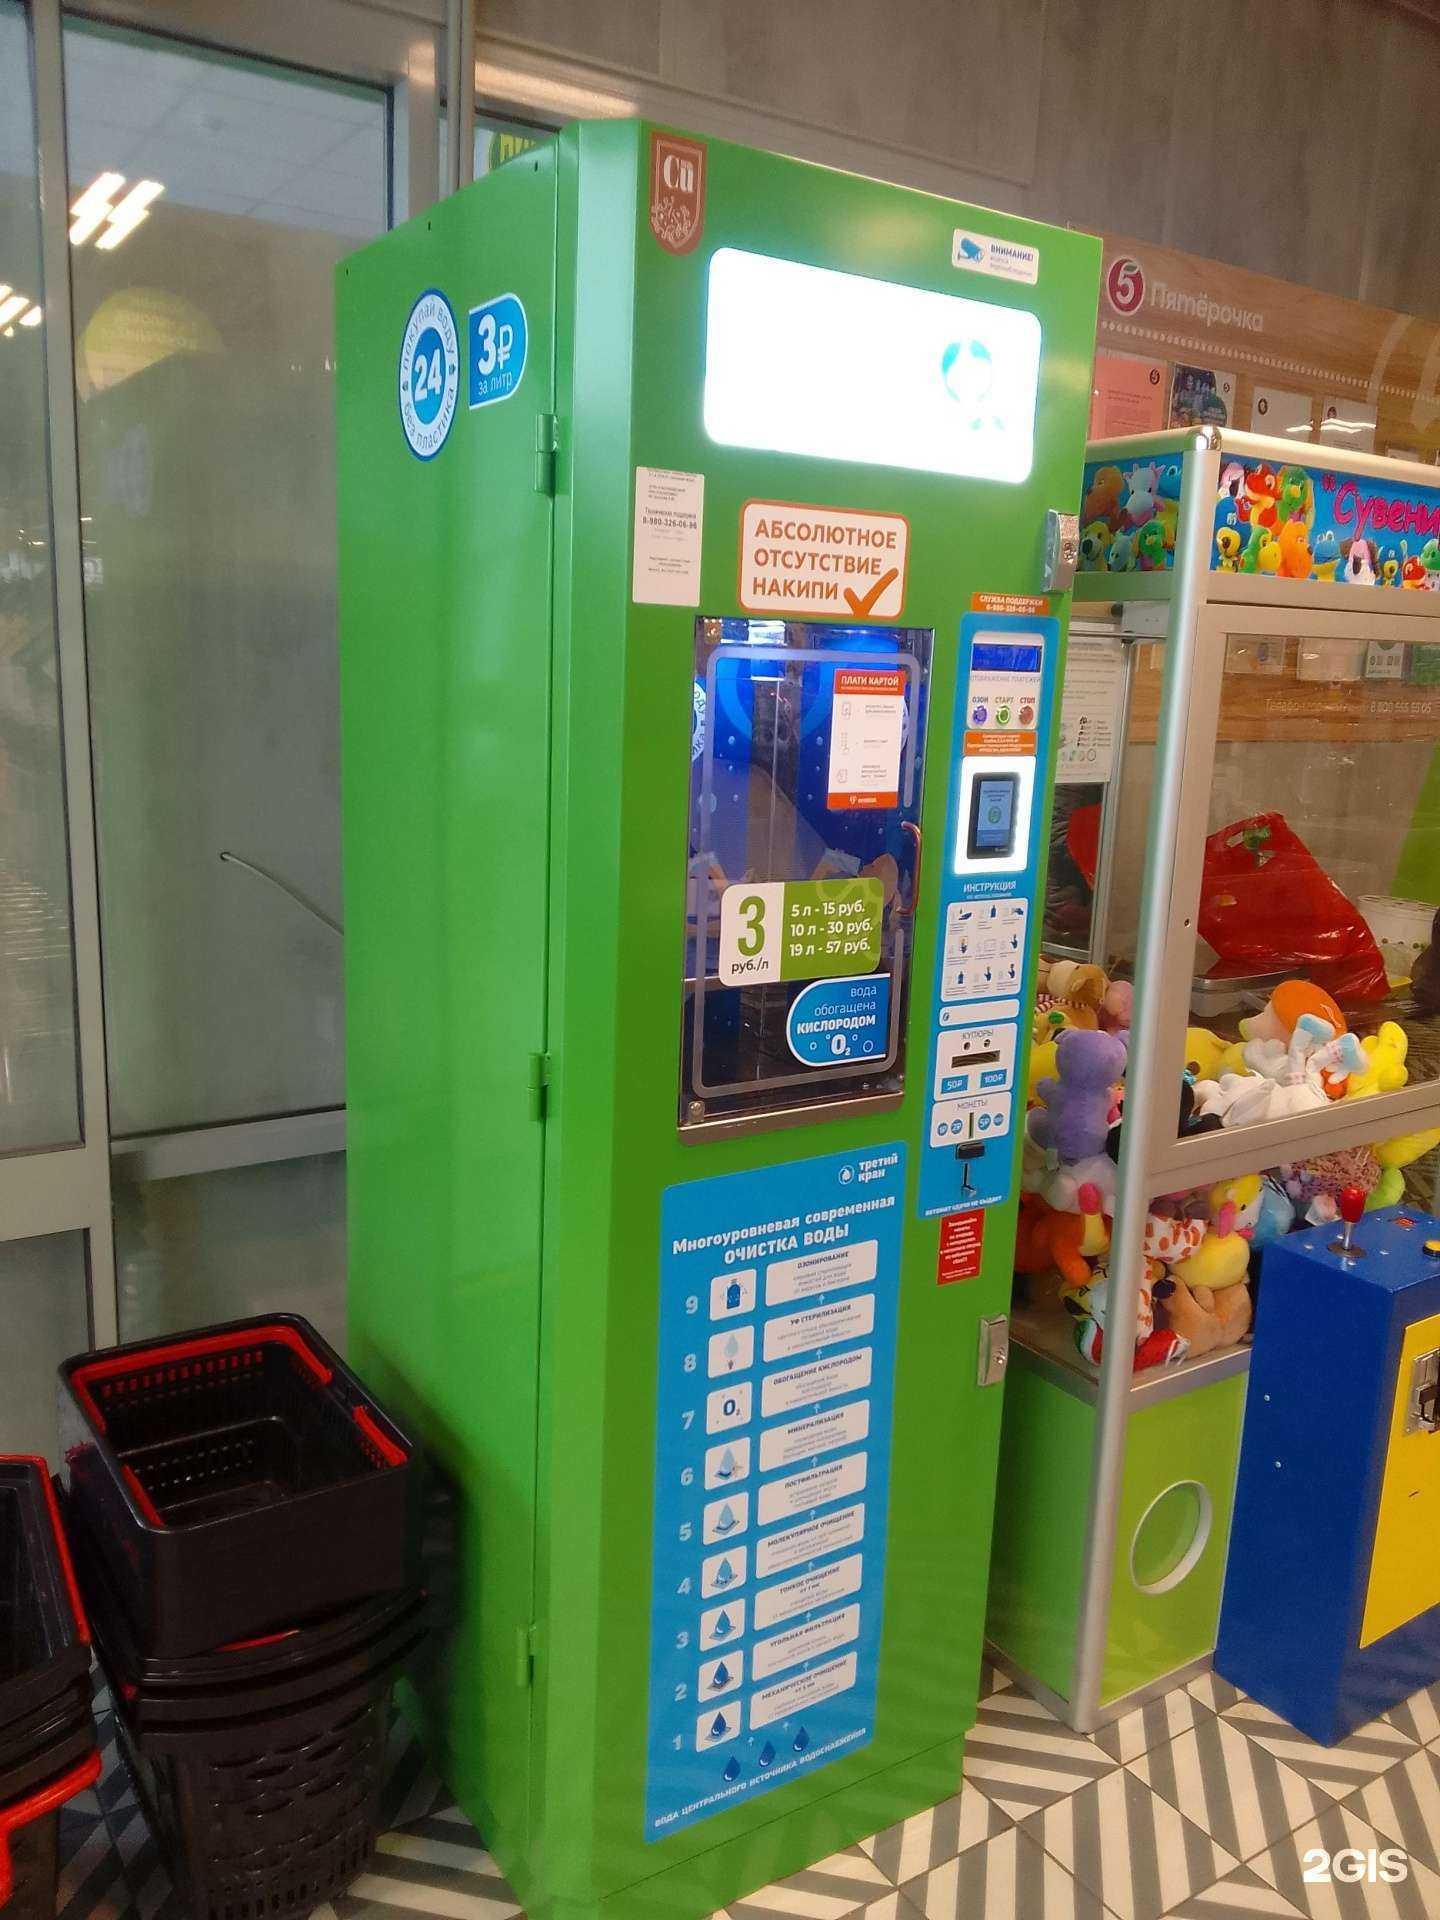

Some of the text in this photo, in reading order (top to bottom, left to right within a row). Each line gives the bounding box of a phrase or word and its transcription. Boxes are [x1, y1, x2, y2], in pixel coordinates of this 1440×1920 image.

[1151, 280, 1265, 332] Пятёрочка
[437, 307, 455, 355] воду
[414, 348, 443, 402] 24
[478, 372, 513, 396] за литр
[416, 388, 455, 450] пластика
[754, 519, 897, 549] АБСОЛЮТНОЕ
[754, 548, 882, 575] ОТСУТСТВИЕ
[753, 577, 839, 600] НАКИПИ
[841, 675, 899, 687] ПЛАТИ КАРТОЙ
[972, 696, 989, 704] ОЗОН
[995, 696, 1013, 704] СТАРТ
[1019, 696, 1035, 704] СТОП
[963, 880, 1017, 893] ИНСТРУКЦИЯ
[791, 904, 800, 917] 5
[802, 905, 812, 916] л
[823, 901, 836, 915] 15
[838, 899, 866, 917] руб.
[737, 895, 766, 957] 3
[790, 923, 804, 937] 10
[807, 924, 816, 935] л
[828, 920, 844, 934] 30
[846, 918, 873, 936] руб.
[789, 943, 802, 957] 19
[805, 943, 815, 956] л
[825, 939, 841, 953] 57
[843, 937, 871, 955] руб.
[731, 957, 769, 975] руб./л
[850, 985, 877, 998] вода
[814, 1001, 876, 1017] обогащена
[797, 1014, 876, 1035] КИСЛОРОДОМ
[962, 1029, 993, 1040] КУПЮРЫ
[957, 1099, 987, 1111] МОНЕТЫ
[859, 1153, 898, 1171] третий
[858, 1169, 885, 1183] кран
[672, 1196, 895, 1254] Многоуровневая современная
[724, 1224, 849, 1265] ОЧИСТКА ВОДЫ
[797, 1251, 849, 1270] ОЗОНИРОВАНИЕ
[685, 1296, 698, 1314] 9
[790, 1304, 851, 1327] УФ СТЕРИЛИЗАЦИЯ
[683, 1353, 697, 1373] 8
[773, 1354, 862, 1385] ОБОГАЩЕНИЕ КИСЛОРОДОМ
[681, 1410, 695, 1430] 7
[788, 1412, 844, 1434] МИНЕРАЛИЗАЦИЯ
[680, 1468, 693, 1486] 6
[785, 1464, 843, 1489] ПОСТФИЛЬТРАЦИЯ
[679, 1522, 692, 1541] 5
[768, 1522, 819, 1547] МОЛЕКУЛЯРНОЕ
[820, 1511, 854, 1531] ОЧИЩЕНИЕ
[677, 1577, 691, 1595] 4
[780, 1566, 840, 1594] ТОНКОЕ ОЧИЩЕНИЕ
[676, 1632, 688, 1649] 3
[770, 1613, 845, 1648] УГОЛЬНАЯ ФИЛЬТРАЦИЯ
[762, 1675, 812, 1700] МЕХАНИЧЕСКОЕ
[813, 1660, 846, 1681] ОЧИЩЕНИЕ
[674, 1684, 687, 1701] 2
[672, 1734, 682, 1750] 1
[654, 1727, 866, 1828] ВОДА ЦЕНТРАЛЬНОГО ИСТОЧНИКА ВОДОСНАБЖЕНИЯ
